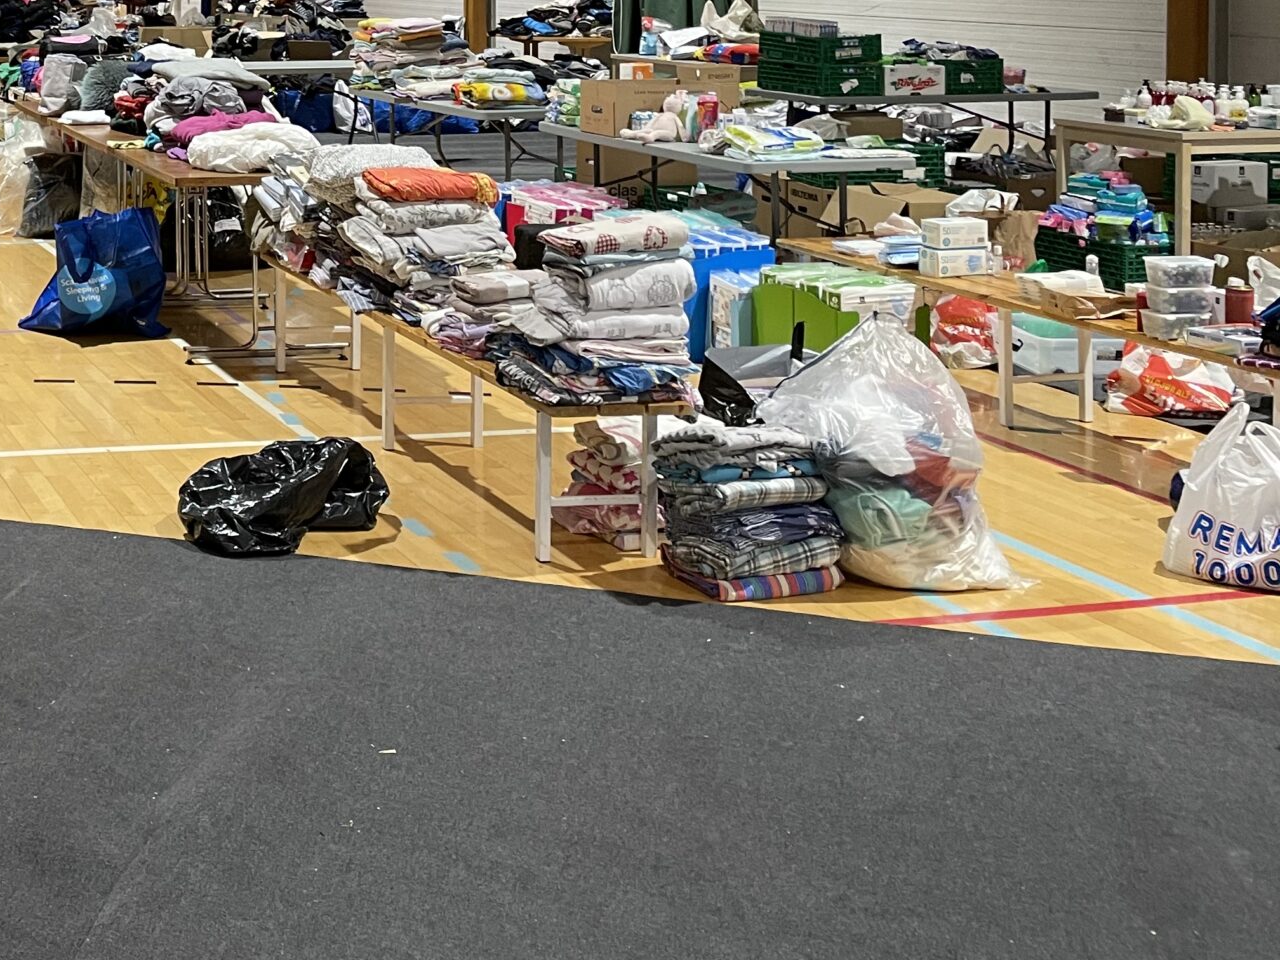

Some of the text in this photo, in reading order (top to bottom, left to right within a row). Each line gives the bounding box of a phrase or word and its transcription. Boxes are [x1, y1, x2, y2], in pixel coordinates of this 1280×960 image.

[609, 184, 638, 199] clas
[66, 286, 100, 296] Sleeping
[77, 292, 101, 303] Living
[1194, 551, 1280, 588] 1000
